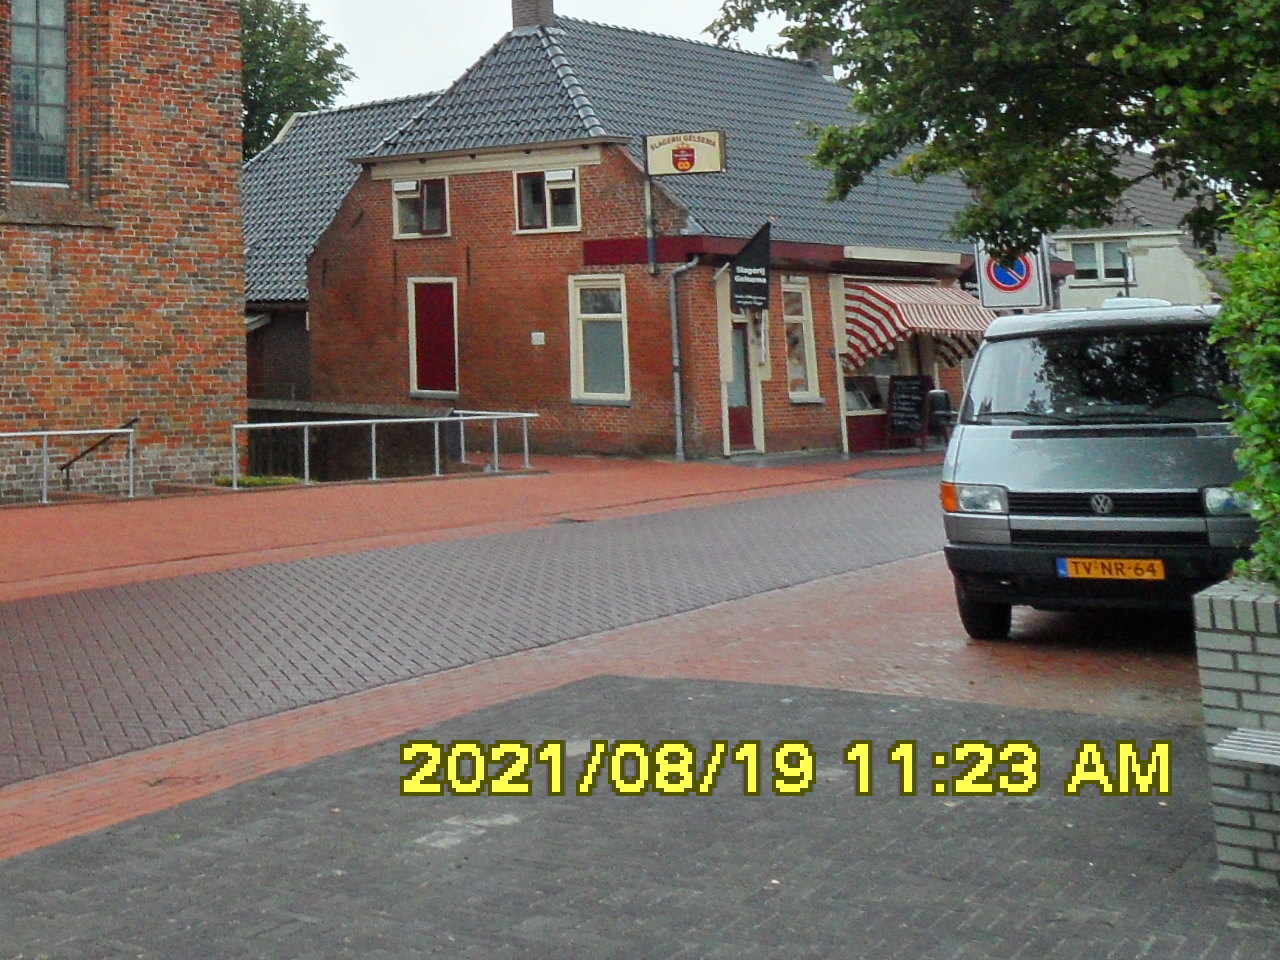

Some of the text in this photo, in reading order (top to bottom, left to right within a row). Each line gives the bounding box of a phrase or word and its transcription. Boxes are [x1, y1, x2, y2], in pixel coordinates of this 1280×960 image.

[683, 134, 716, 147] GELSEMA
[736, 266, 765, 276] Slagerij
[734, 275, 767, 283] Gelsema
[1070, 561, 1157, 576] TV-NR-64
